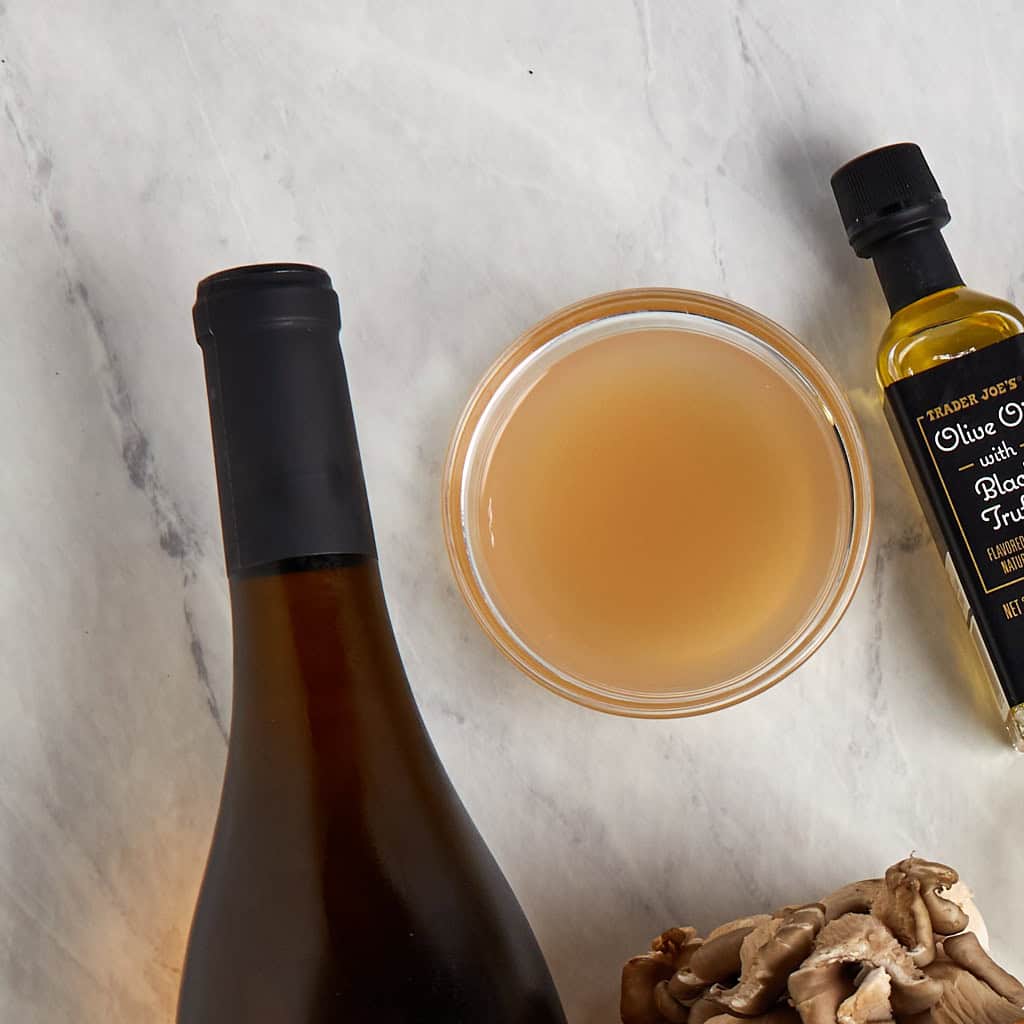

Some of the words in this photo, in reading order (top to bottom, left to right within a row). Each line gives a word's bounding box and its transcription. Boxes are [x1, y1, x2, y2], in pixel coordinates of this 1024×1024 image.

[926, 393, 979, 422] TRADER
[981, 377, 1018, 400] JOE'S
[934, 422, 997, 452] Olive
[979, 440, 1018, 467] with
[1002, 599, 1022, 620] NET
